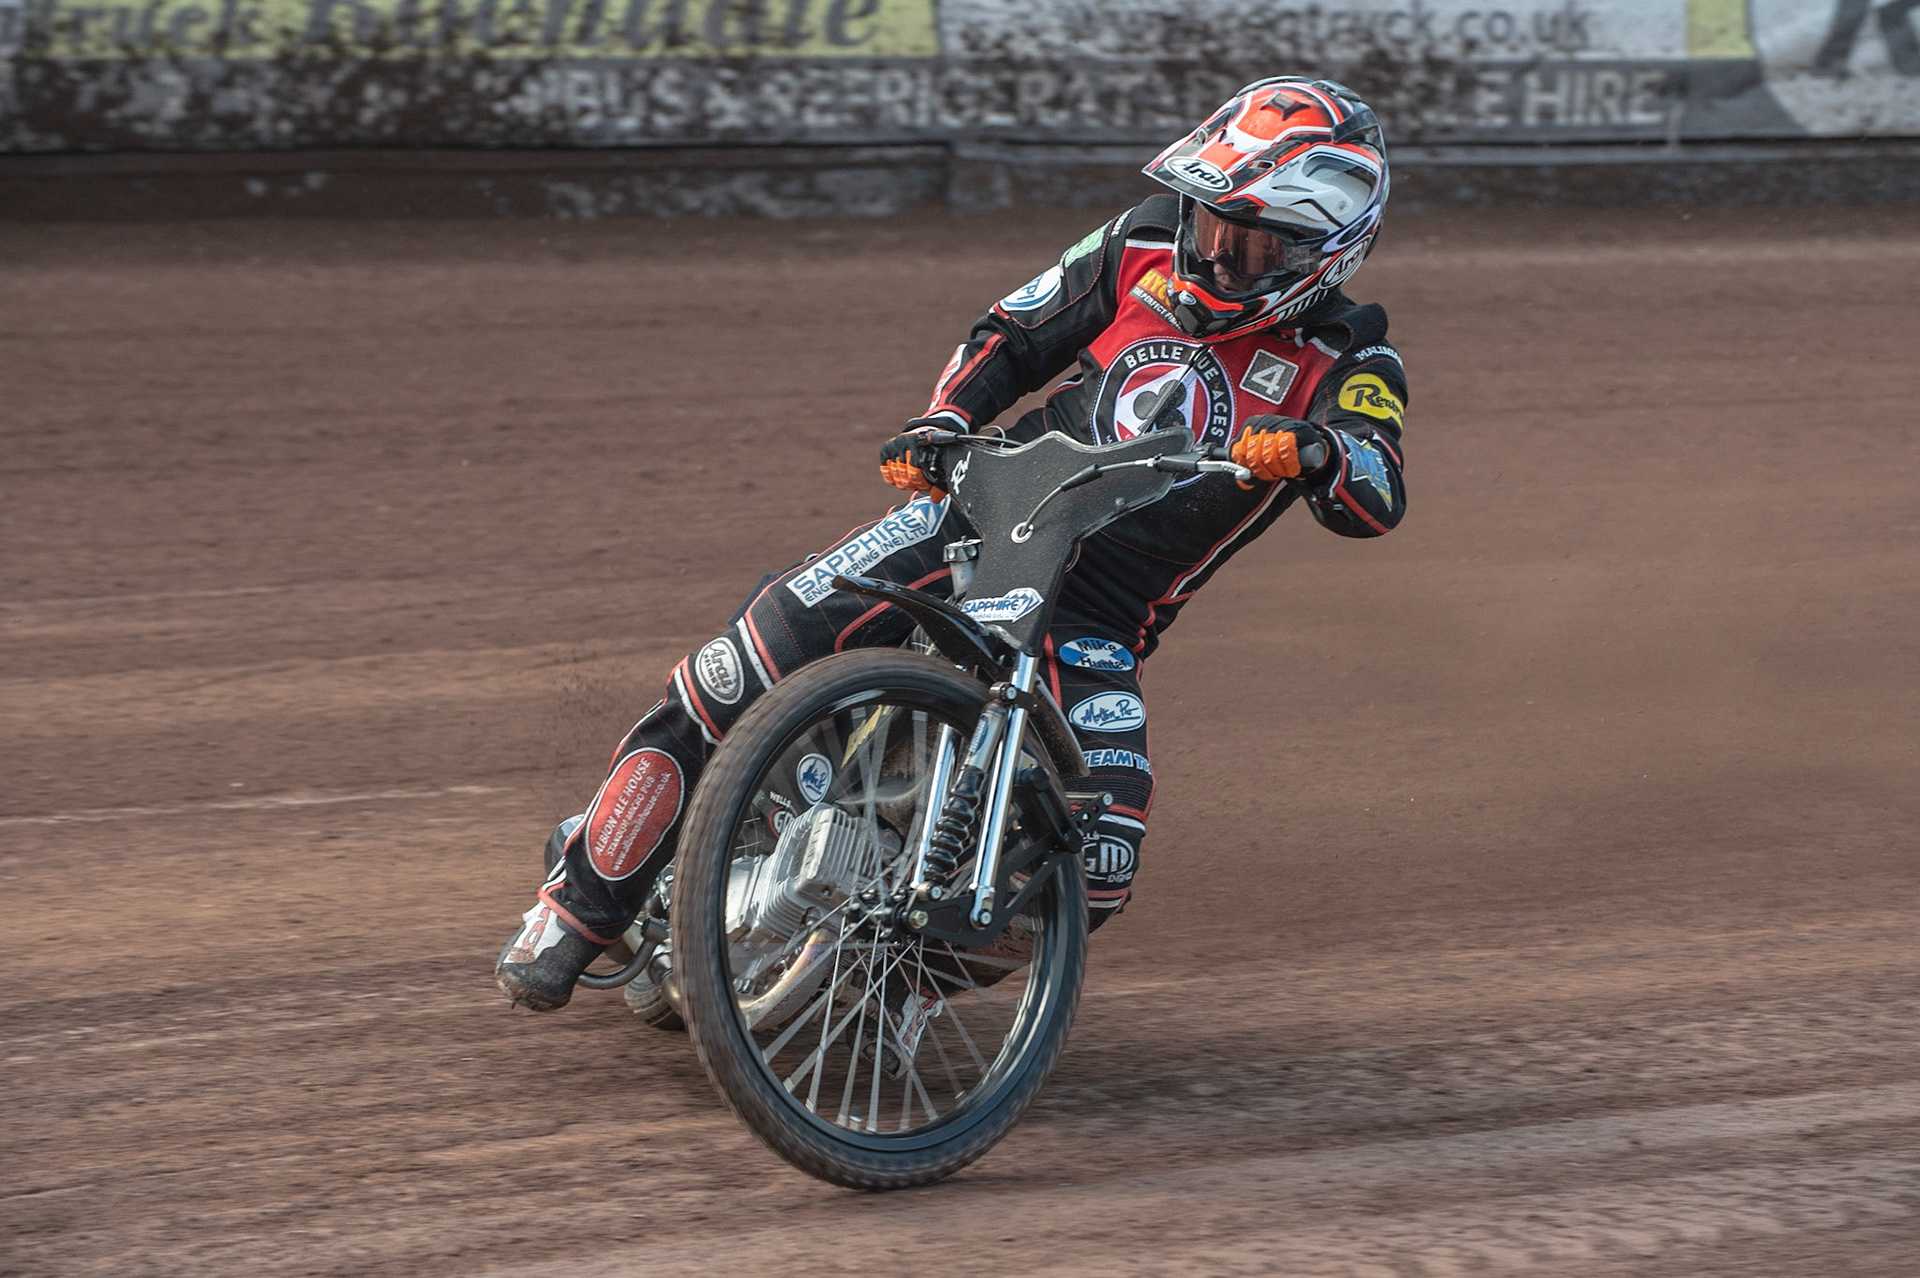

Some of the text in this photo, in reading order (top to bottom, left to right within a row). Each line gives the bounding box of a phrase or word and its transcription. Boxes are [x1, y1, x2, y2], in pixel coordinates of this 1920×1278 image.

[1523, 69, 1668, 127] HIRE
[1124, 344, 1183, 369] BELLE
[1210, 388, 1229, 438] ACES
[1251, 363, 1286, 396] 4
[908, 526, 928, 541] LTD
[794, 513, 921, 595] SAPPHIRE
[964, 600, 1019, 613] SAPPHIRE
[1076, 640, 1117, 653] Mike
[1080, 657, 1127, 670] Hunter
[709, 645, 734, 690] Arai
[1083, 749, 1134, 768] TEAM
[594, 756, 652, 857] ALBION ALE HOUSE
[626, 790, 645, 821] MICRO
[642, 775, 656, 794] PUB
